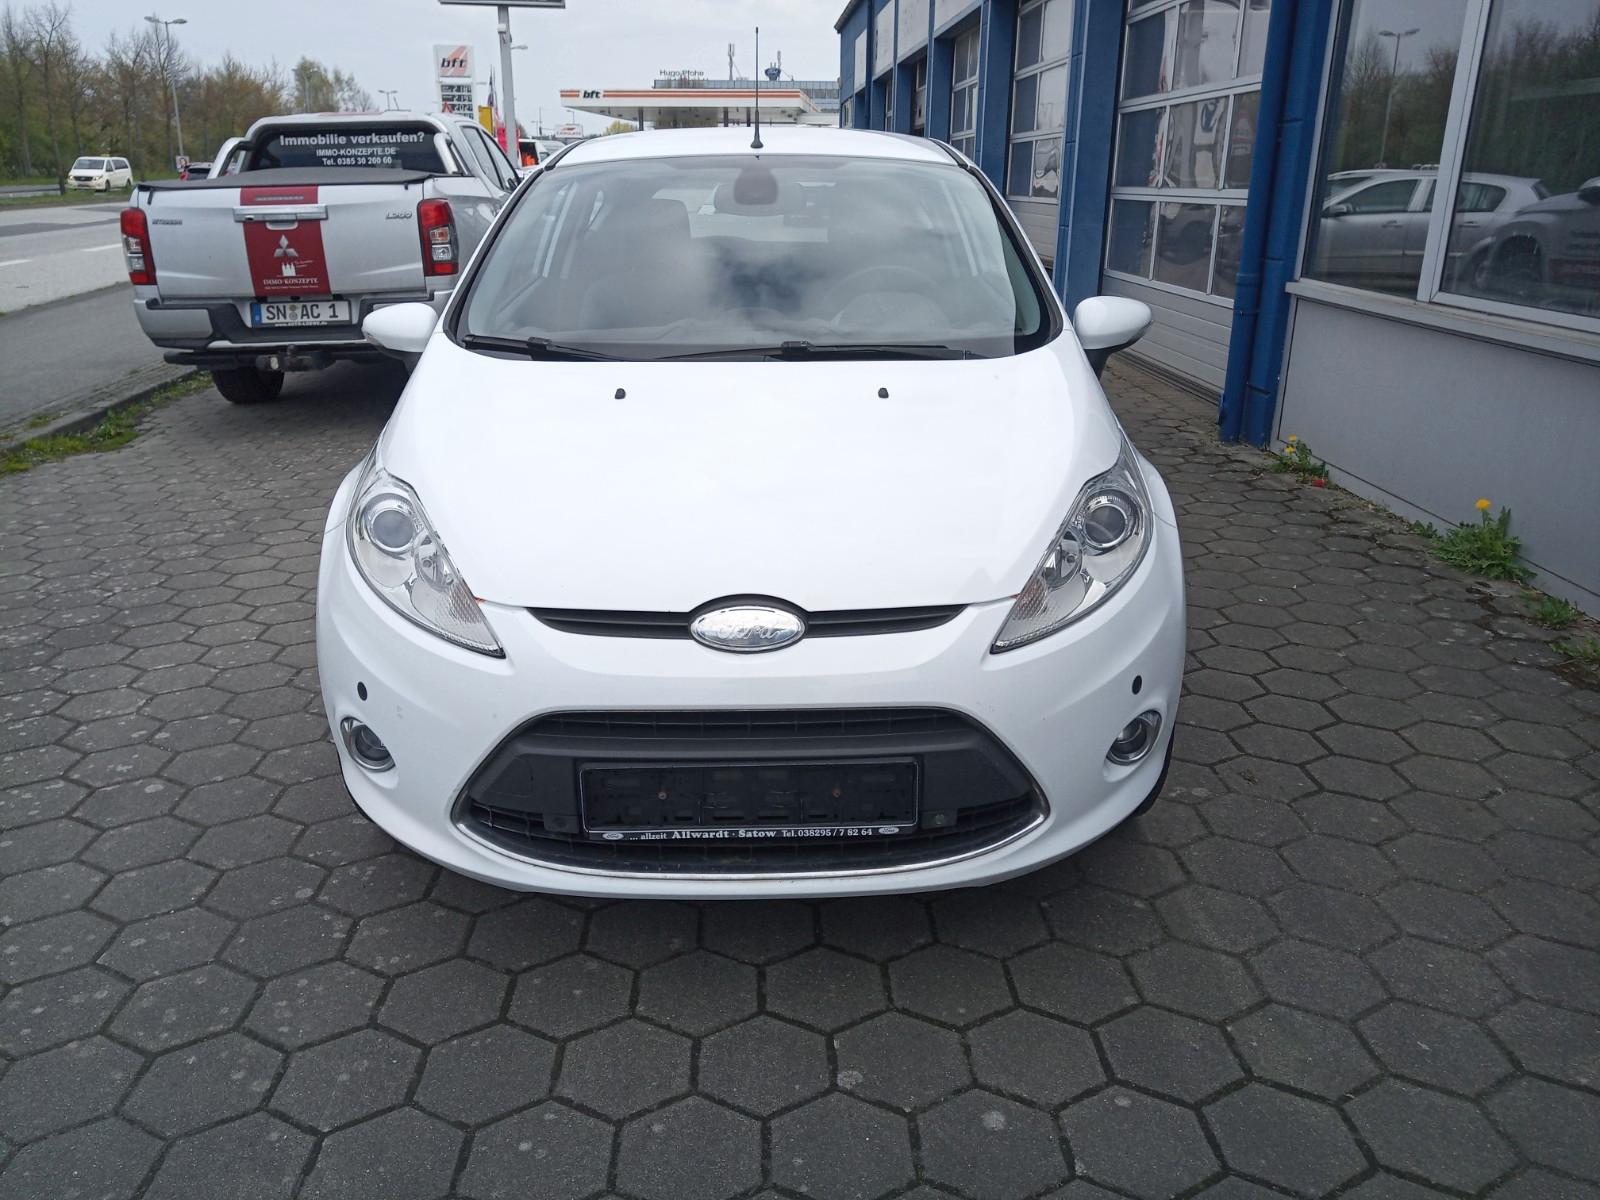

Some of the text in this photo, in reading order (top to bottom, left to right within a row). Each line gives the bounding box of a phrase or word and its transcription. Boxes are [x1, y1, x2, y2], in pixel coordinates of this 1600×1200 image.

[441, 57, 466, 68] bft
[583, 89, 600, 99] bft
[280, 132, 425, 146] Immobilie verkaufen?
[337, 157, 356, 165] 0385
[357, 157, 366, 165] 30
[367, 156, 381, 164] 200
[266, 303, 339, 320] SN AC 1
[640, 832, 668, 840] allzeit
[671, 829, 730, 839] Allwardt
[738, 829, 777, 838] Satow
[847, 828, 859, 836] 82
[861, 827, 873, 836] 64
